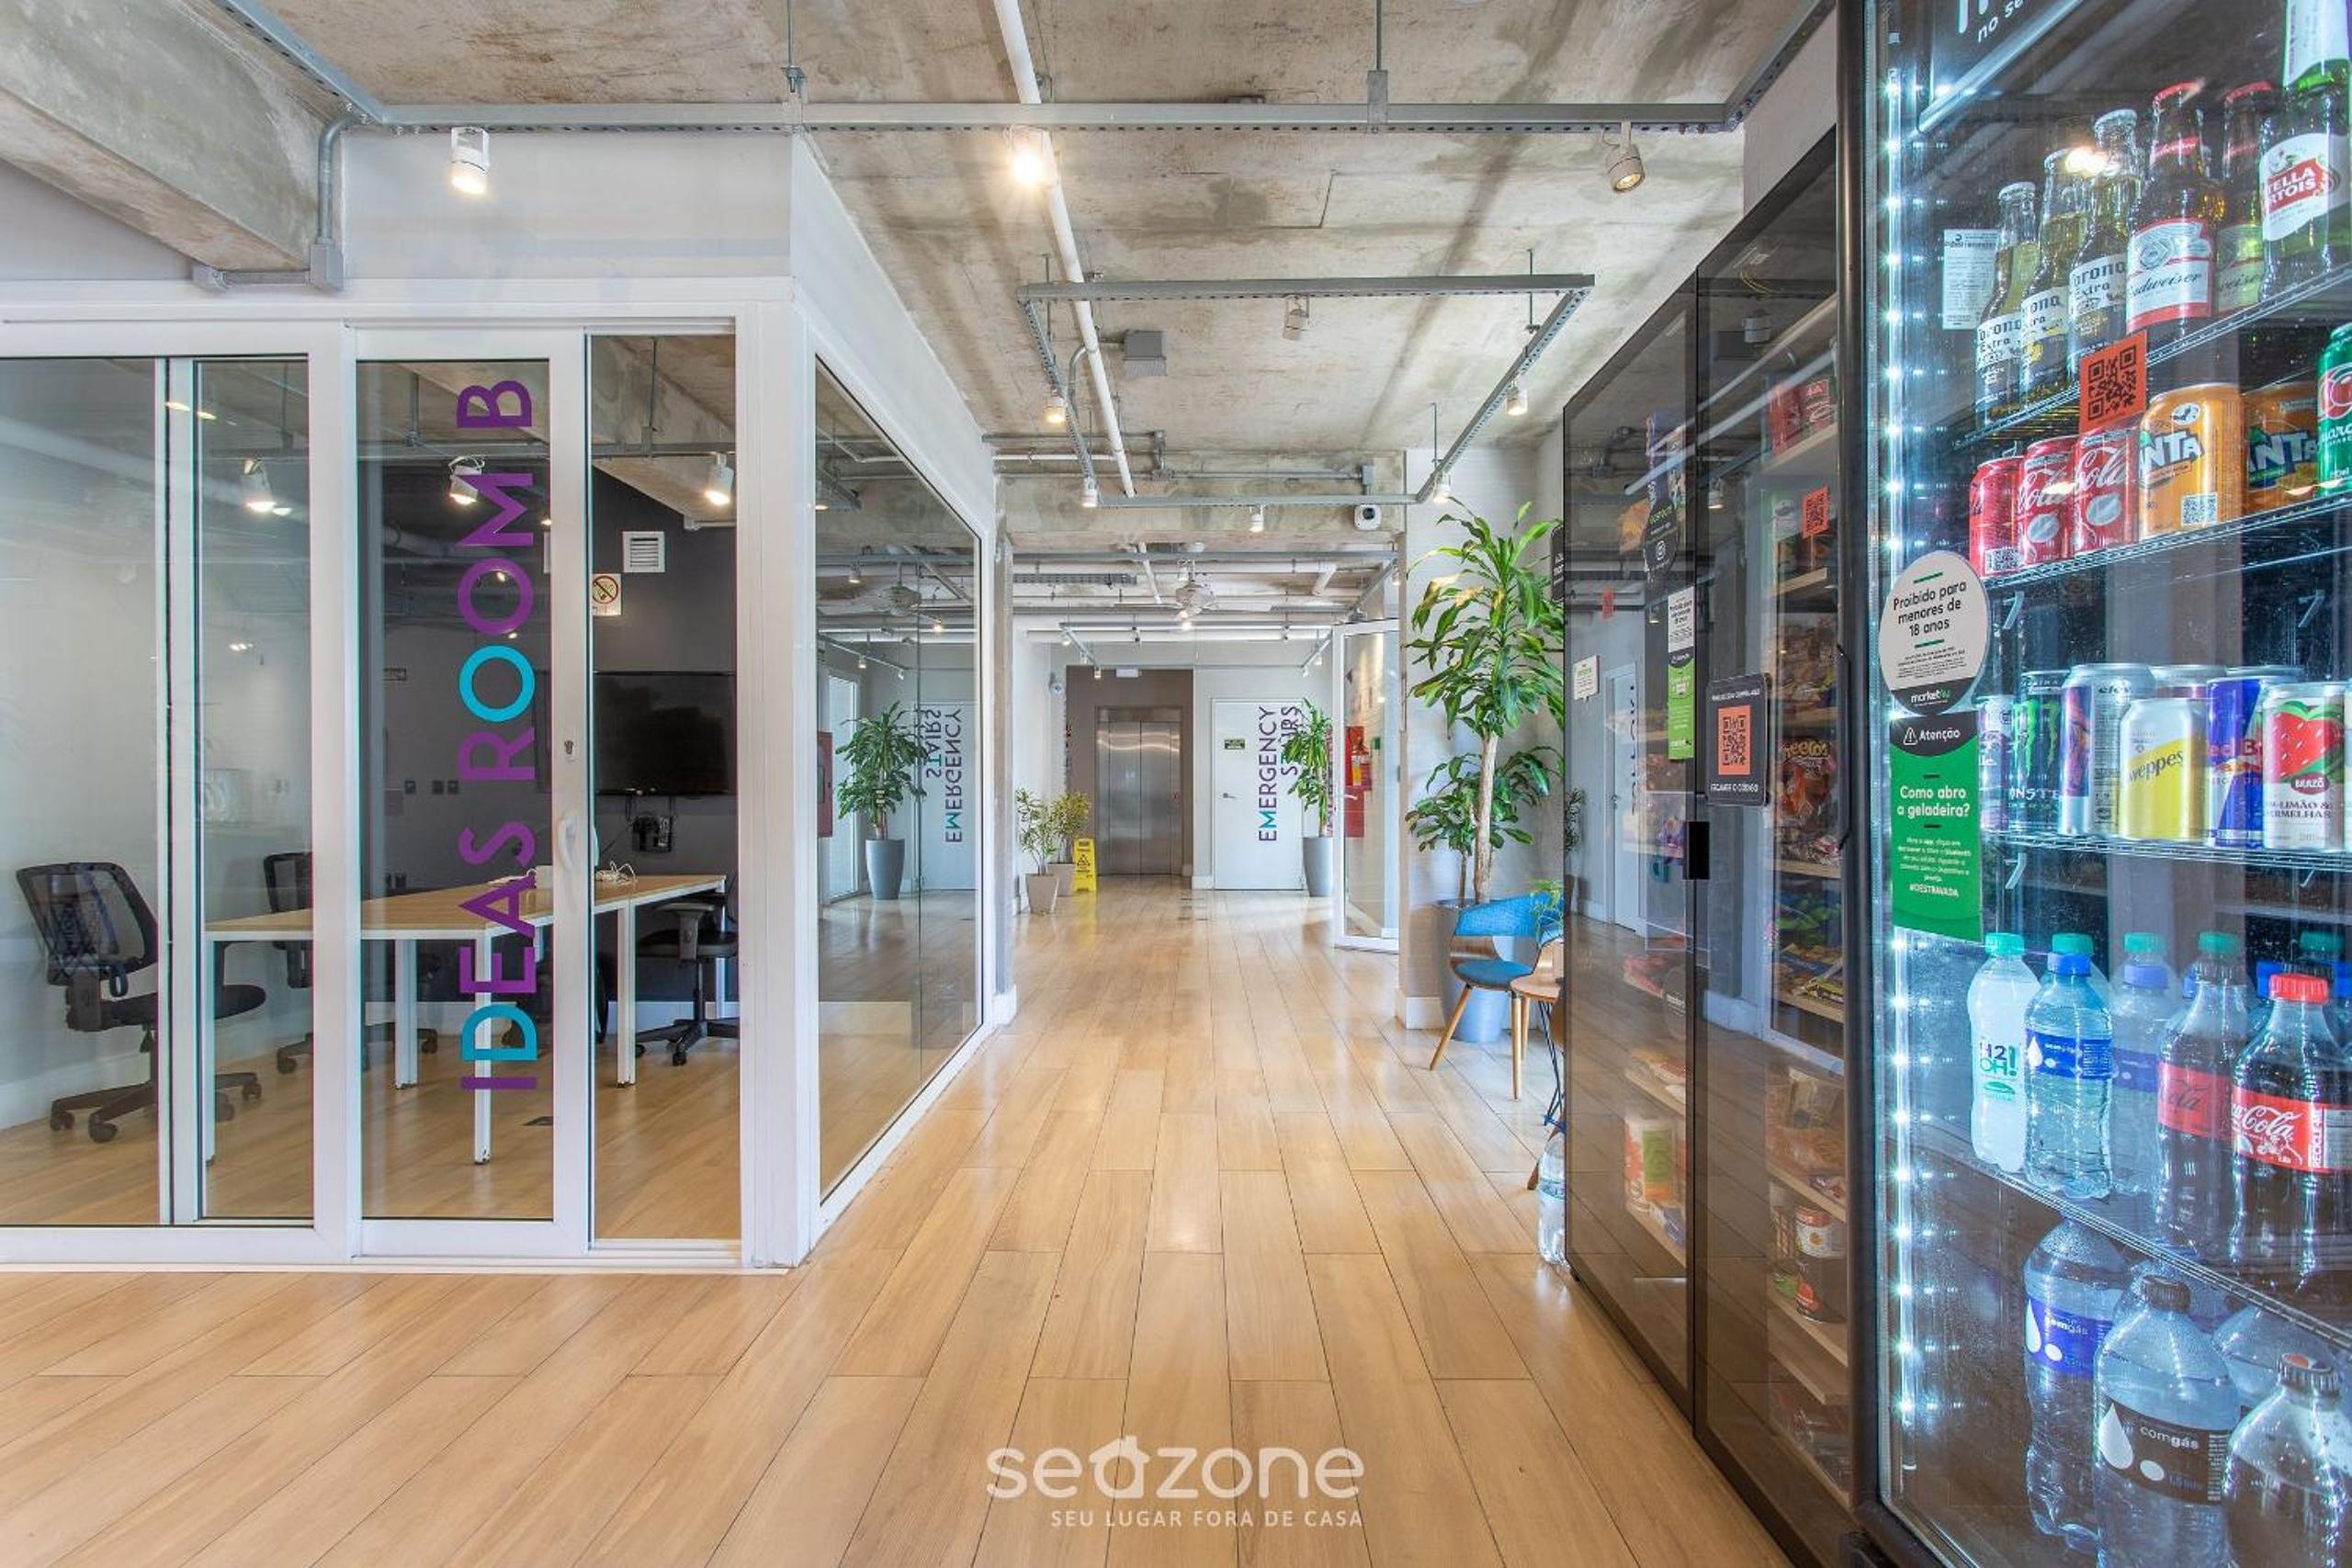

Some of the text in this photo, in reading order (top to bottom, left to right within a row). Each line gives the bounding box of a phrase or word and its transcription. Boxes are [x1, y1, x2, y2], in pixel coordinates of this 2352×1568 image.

[2140, 430, 2203, 476] NTA
[1894, 581, 1967, 610] Proibido para
[1898, 597, 1962, 625] menores de
[1909, 618, 1950, 637] 18 anos
[456, 379, 538, 1091] IDEAS ROOM B
[1919, 727, 1961, 742] Atenção
[1259, 705, 1277, 841] EMERGENCY
[2127, 750, 2184, 782] weppes
[1900, 784, 1966, 799] Como abro
[1896, 802, 1971, 819] a geladeira?
